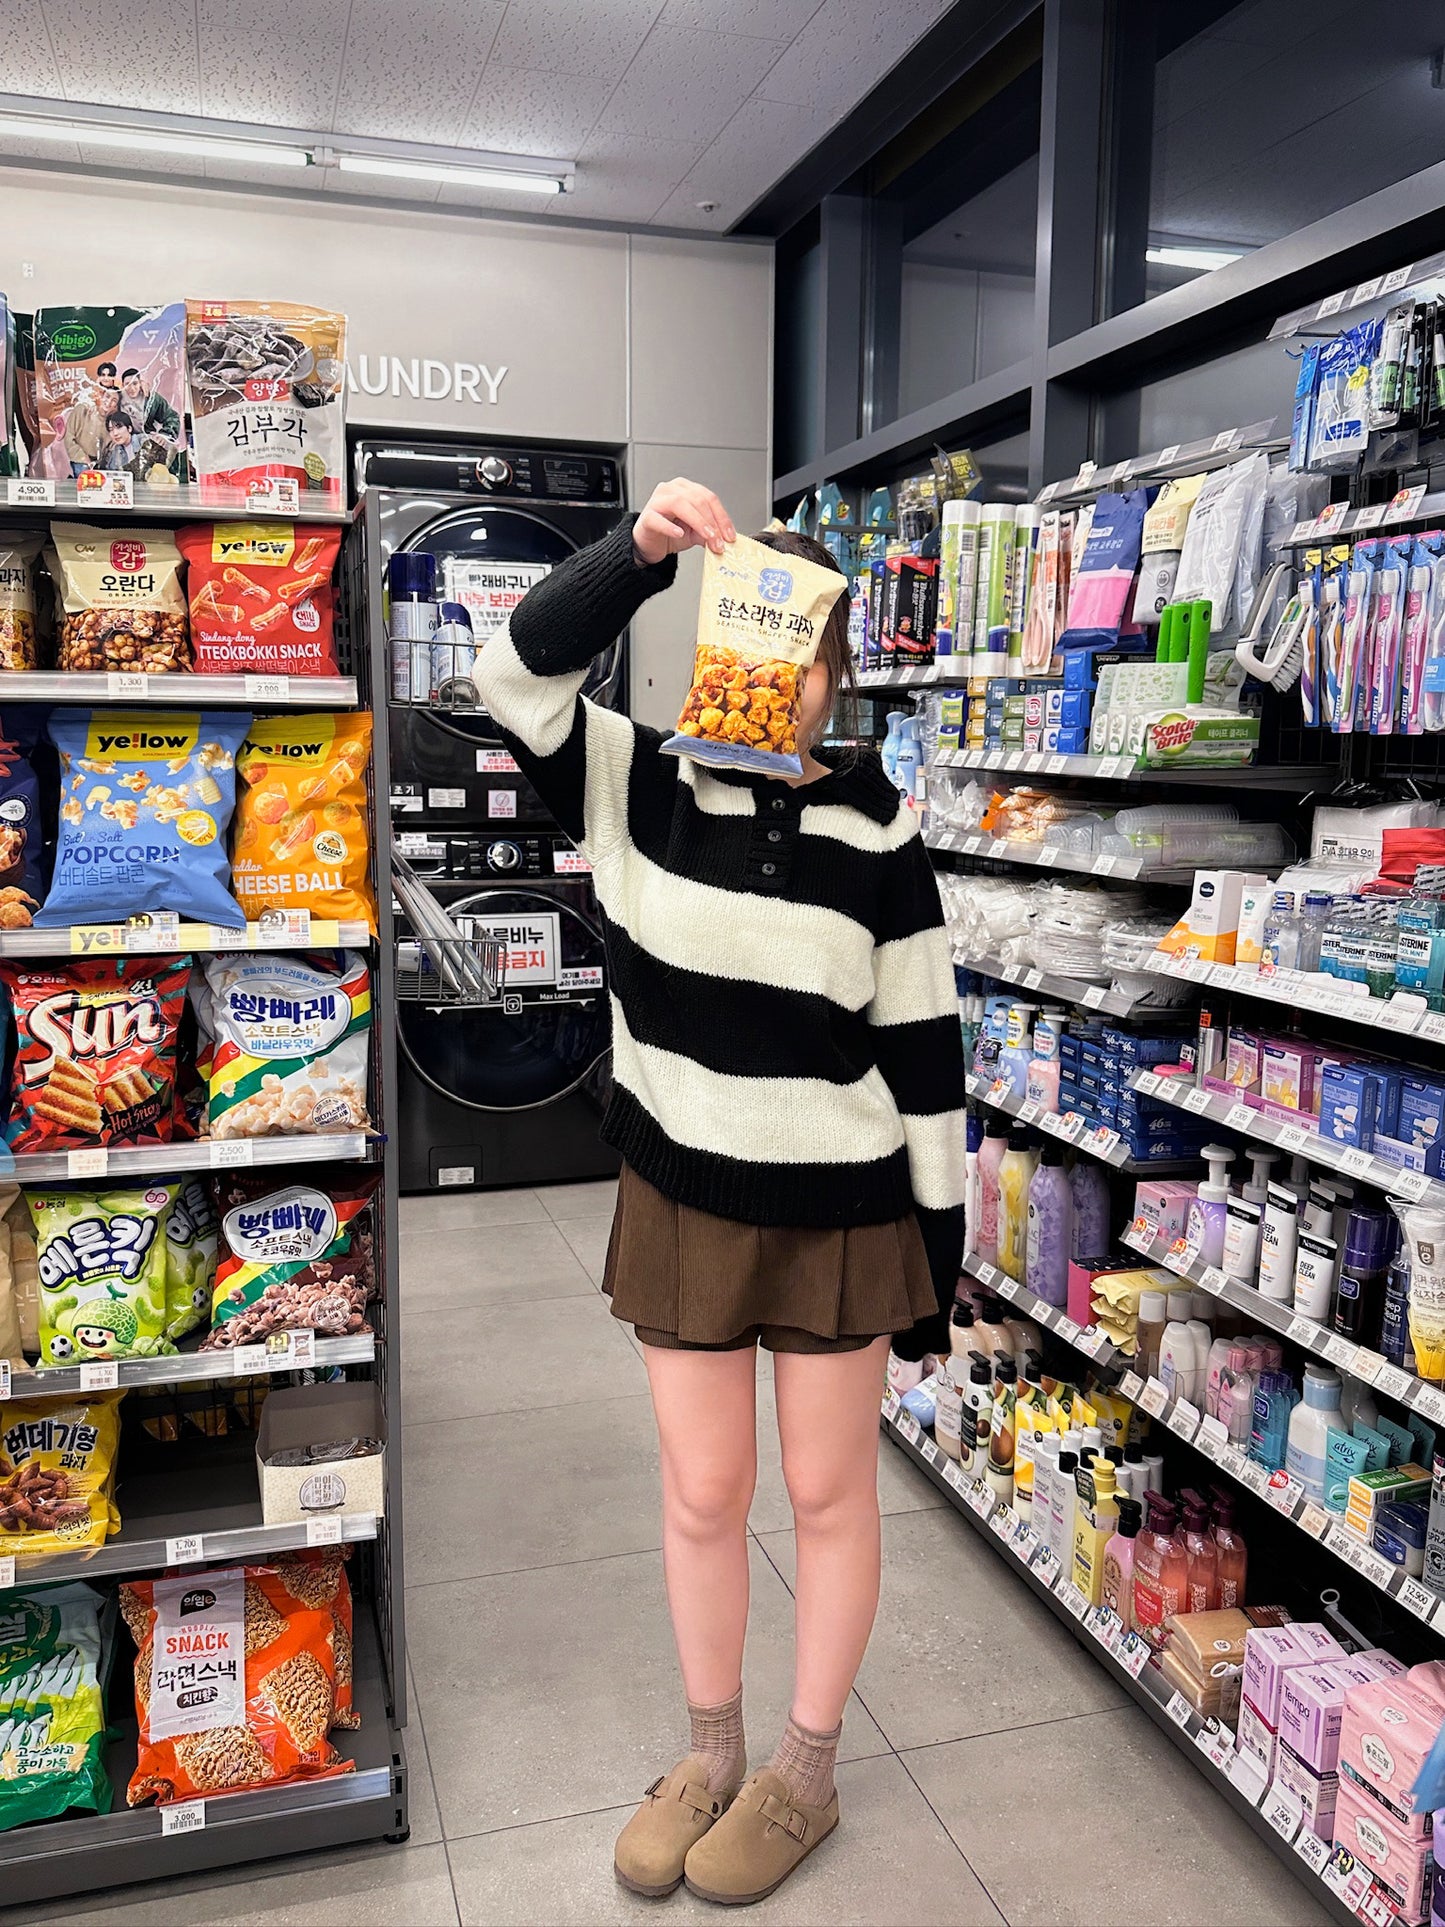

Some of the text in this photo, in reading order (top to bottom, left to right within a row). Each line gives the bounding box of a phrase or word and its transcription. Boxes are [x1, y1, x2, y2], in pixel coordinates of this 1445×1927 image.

[54, 333, 93, 349] bibigo
[227, 413, 308, 447] 김부각
[81, 473, 102, 488] 1+1
[249, 481, 270, 493] 2+1
[18, 486, 45, 495] 4,900
[117, 552, 140, 569] 갑
[99, 574, 156, 592] 오란다
[468, 574, 532, 589] 빨래바구니
[718, 597, 815, 639] 참소라형 과자
[200, 643, 323, 660] TTEOKBOKKI SNACK
[300, 660, 321, 674] 스낵
[119, 677, 142, 686] 1,300
[1400, 694, 1408, 725] 2080
[1156, 731, 1192, 750] Brite
[1207, 728, 1249, 738] 테이프 클리너
[96, 831, 123, 843] Salt
[61, 846, 180, 865] POPCORN
[317, 842, 343, 857] Cheese
[1321, 845, 1337, 857] EVA
[59, 864, 145, 887] 버터솔트 팝콘
[295, 871, 343, 893] BALL
[129, 916, 150, 928] 1+1
[262, 912, 283, 925] 2+1
[30, 975, 67, 984] 오리온
[230, 993, 336, 1025] 빵빠레
[22, 990, 164, 1086] Sun
[245, 1023, 322, 1038] 소프트스낵
[110, 1114, 132, 1135] Hot
[1284, 1130, 1301, 1142] 2,500
[219, 1146, 244, 1156] 2,500
[1300, 1260, 1315, 1270] DEEP
[1298, 1267, 1317, 1281] CLEAN
[268, 1333, 289, 1348] 1+1
[3, 1421, 99, 1466] 번데기형
[1334, 1441, 1357, 1460] atrix
[59, 1453, 87, 1471] 과자
[1406, 1583, 1429, 1605] 12,900
[166, 1632, 229, 1654] SNACK
[1247, 1643, 1267, 1675] Tempo
[157, 1660, 238, 1692] 라면스낵
[1283, 1684, 1311, 1718] Tempo
[17, 1757, 69, 1774] 풍미 가득
[174, 1812, 196, 1822] 3,000
[1274, 1804, 1291, 1825] 7,900
[1304, 1837, 1322, 1857] 7,900
[1363, 1891, 1394, 1926] 1+1
